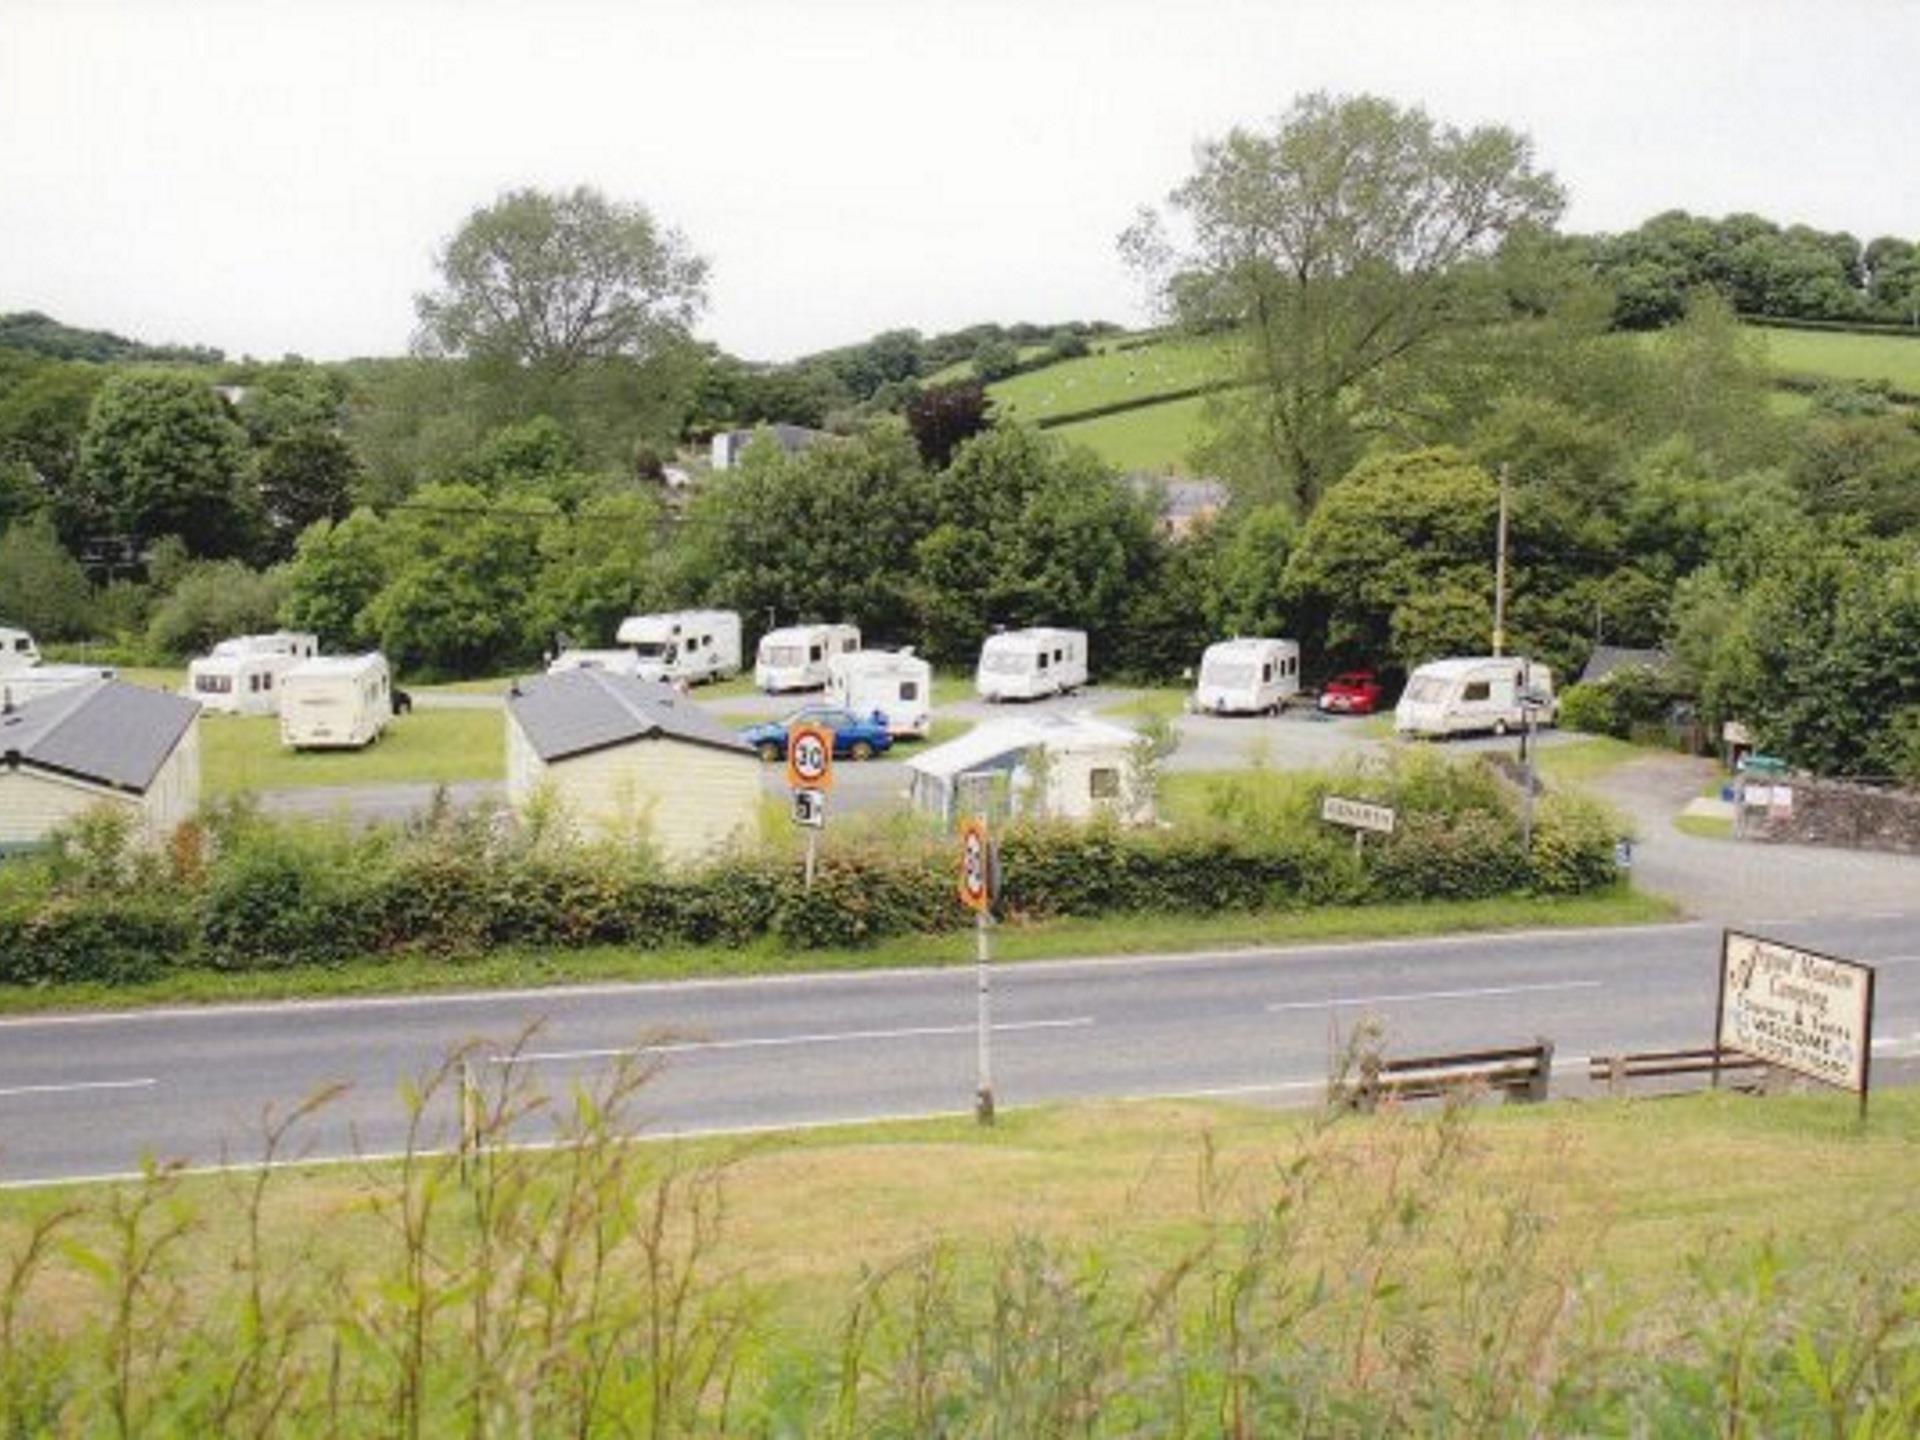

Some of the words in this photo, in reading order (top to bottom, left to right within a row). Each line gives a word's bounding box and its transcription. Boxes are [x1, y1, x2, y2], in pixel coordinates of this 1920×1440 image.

[798, 745, 822, 769] 30
[1794, 1008, 1804, 1026] &
[1753, 1017, 1832, 1055] WELCOME
